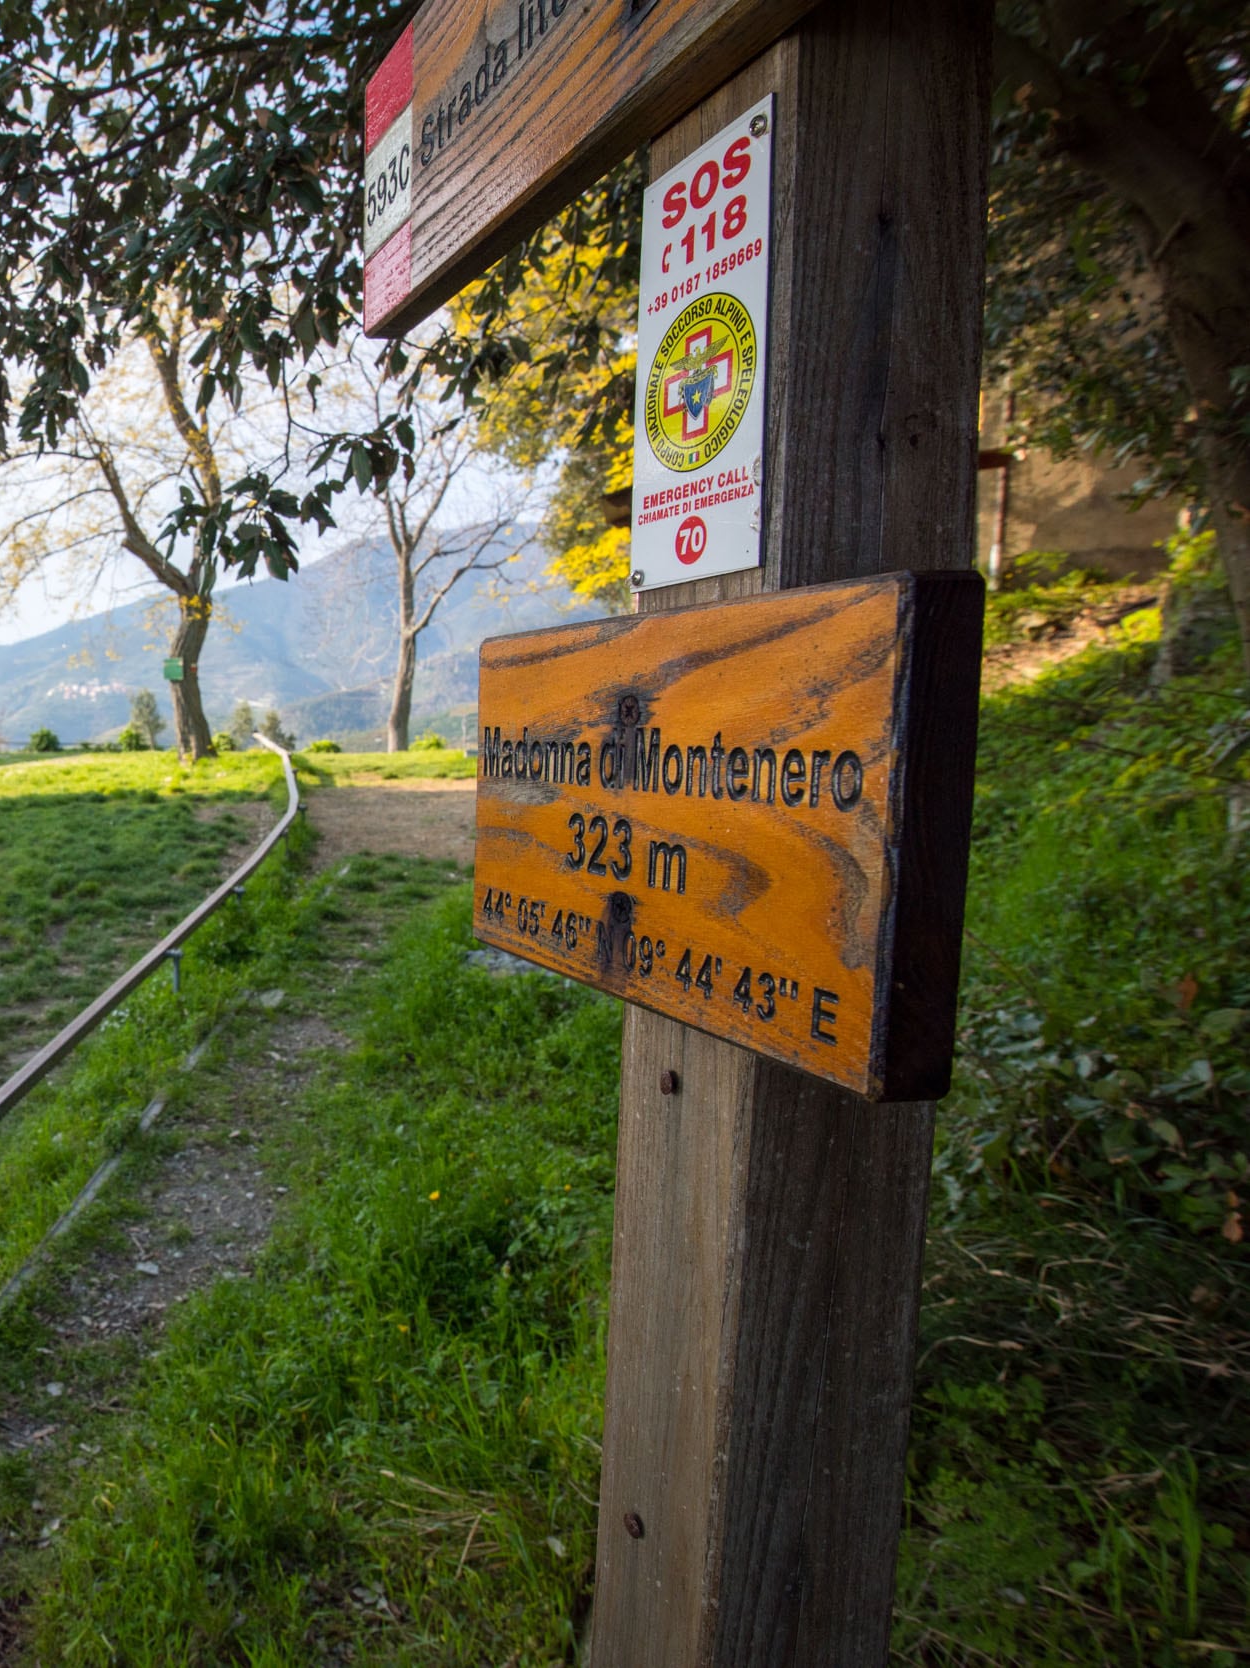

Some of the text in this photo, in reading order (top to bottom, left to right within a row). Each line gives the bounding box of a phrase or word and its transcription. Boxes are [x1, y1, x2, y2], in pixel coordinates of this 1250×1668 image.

[420, 38, 508, 167] Strada
[366, 143, 410, 227] 593C
[661, 136, 751, 229] SOS
[681, 194, 747, 265] 118
[647, 238, 763, 316] +39 0187 1859669
[647, 297, 754, 468] CORPO NAZIONALE SOCCORSO ALPINO E SPELEOLOGICO
[638, 483, 755, 526] CHIAMATE DI EMERGENZA
[643, 465, 749, 510] EMERGENCY CALL
[679, 525, 704, 555] 70
[483, 726, 864, 812] Madonna di Montenero
[566, 812, 688, 895] 323 m
[596, 920, 614, 964] N
[811, 986, 840, 1047] E
